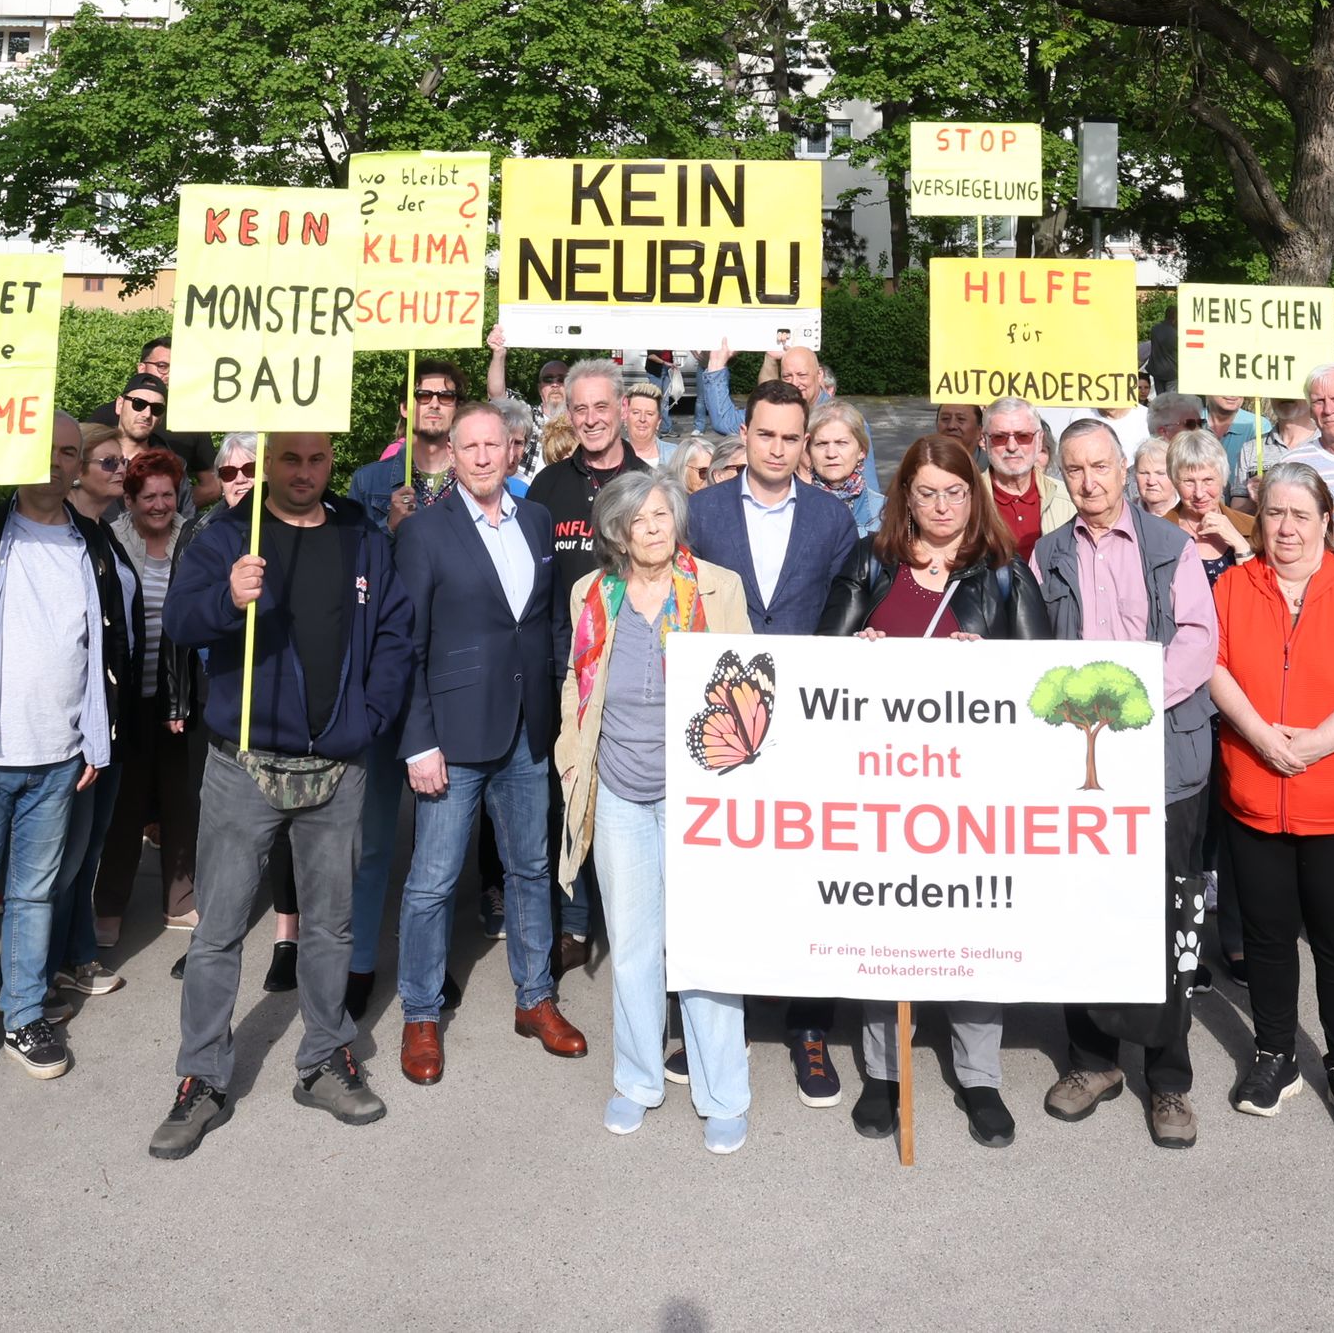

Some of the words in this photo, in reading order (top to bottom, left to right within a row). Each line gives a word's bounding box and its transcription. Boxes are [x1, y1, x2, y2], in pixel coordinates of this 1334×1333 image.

[936, 129, 1017, 152] STOP
[359, 173, 386, 184] wo
[402, 164, 459, 186] bleibt
[912, 179, 1039, 201] VERSIEGELUNG
[397, 195, 425, 212] der
[570, 164, 747, 228] KEIN
[204, 207, 330, 246] KEIN
[363, 232, 469, 264] KLIMA
[519, 239, 800, 305] NEUBAU
[964, 271, 1092, 305] HILFE
[185, 284, 355, 336] MONSTER
[356, 289, 480, 324] SCHUTZ
[1007, 323, 1043, 344] für
[213, 355, 321, 406] BAU
[1220, 353, 1296, 381] RECHT
[799, 687, 868, 721] Wir
[882, 691, 1017, 724] wollen
[858, 744, 961, 778] nicht
[682, 796, 1151, 855] ZUBETONIERT
[817, 875, 1013, 909] werden!!!
[809, 943, 833, 955] Für
[837, 944, 866, 957] eine
[871, 945, 956, 959] lebenswerte
[960, 947, 1023, 963] Siedlung
[857, 963, 975, 977] Autokaderstraße
